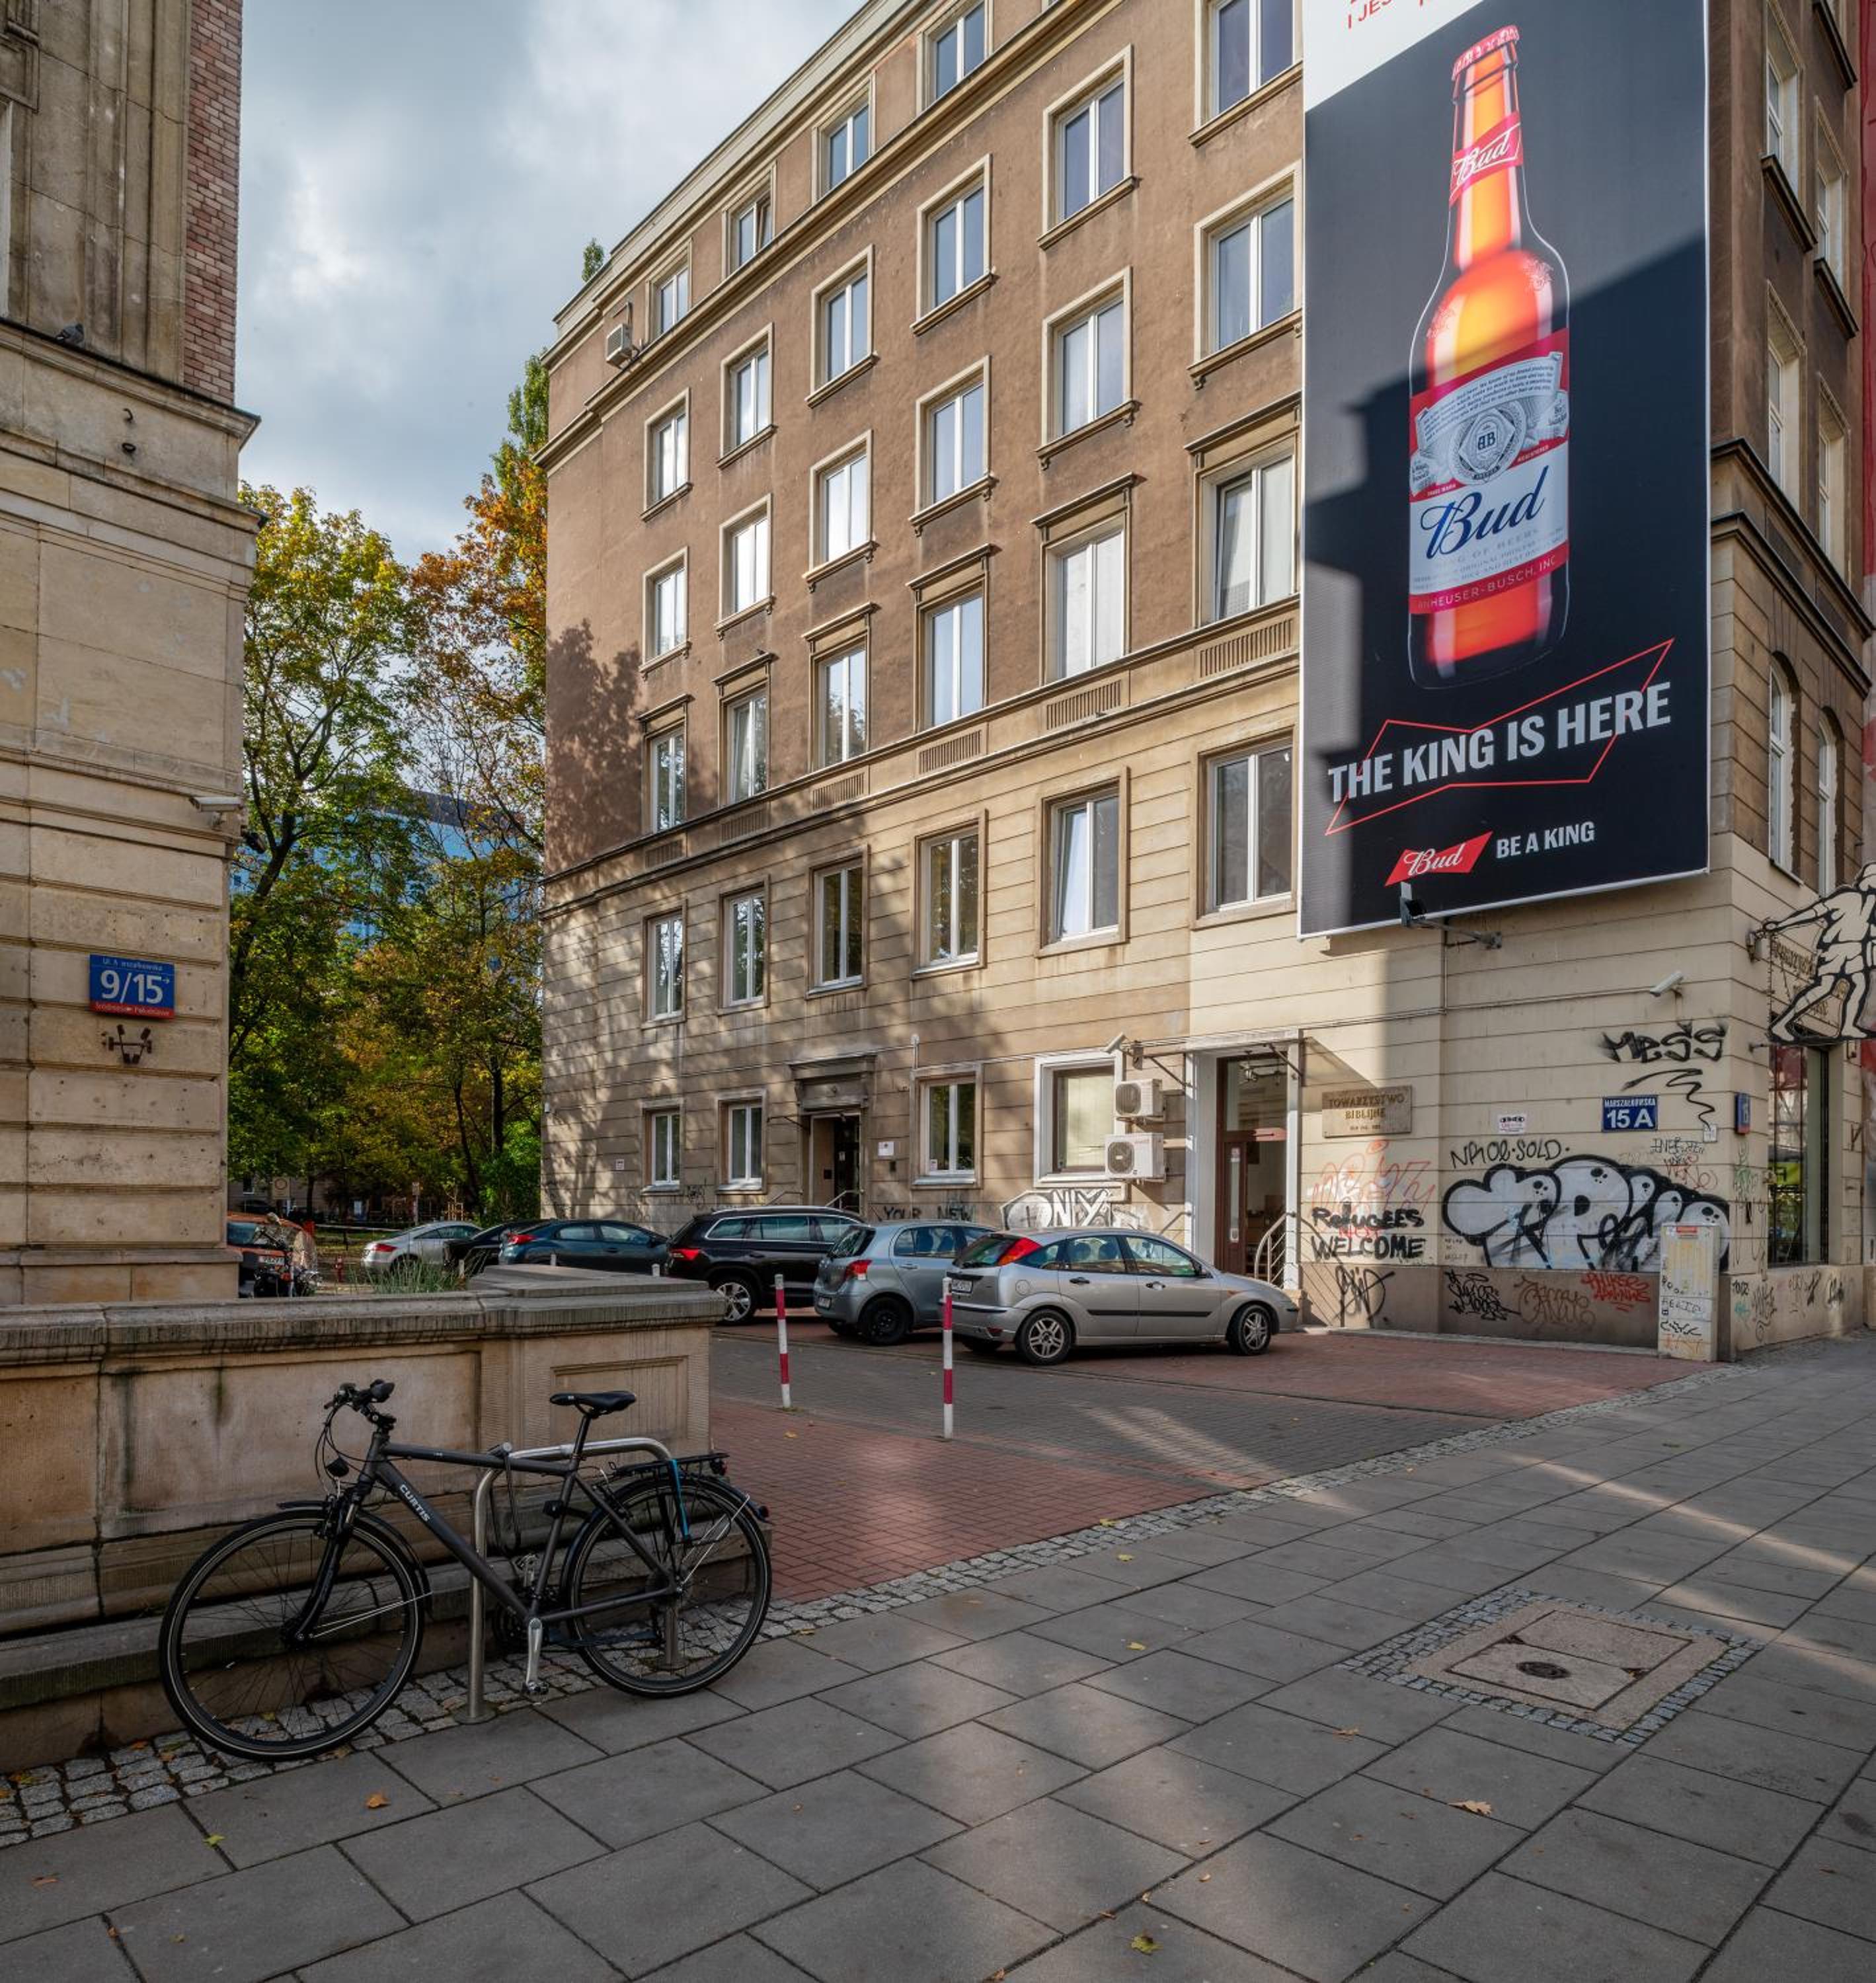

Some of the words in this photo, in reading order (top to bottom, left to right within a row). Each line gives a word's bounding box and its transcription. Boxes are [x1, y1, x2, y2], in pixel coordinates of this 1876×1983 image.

[1454, 129, 1511, 188] Bud
[1421, 465, 1549, 559] Bud
[1327, 754, 1393, 803] THE
[1403, 729, 1495, 787] KING
[1507, 715, 1545, 761] IS
[1557, 681, 1672, 750] HERE
[1403, 845, 1466, 876] Bud
[1497, 837, 1522, 859] BE
[1526, 833, 1540, 853] A
[1544, 821, 1595, 852] KING
[100, 970, 163, 1004] 9/15
[1329, 1093, 1405, 1108] TOWARZYSTWO
[1345, 1108, 1386, 1120] BIBLIJNE
[1604, 1097, 1657, 1107] MARSZAŁKOWSKA
[1607, 1109, 1631, 1129] 15
[1633, 1108, 1654, 1127] A
[883, 1205, 922, 1220] YOUR
[1311, 1233, 1428, 1263] WELCOME
[399, 1484, 430, 1522] CURTIS
